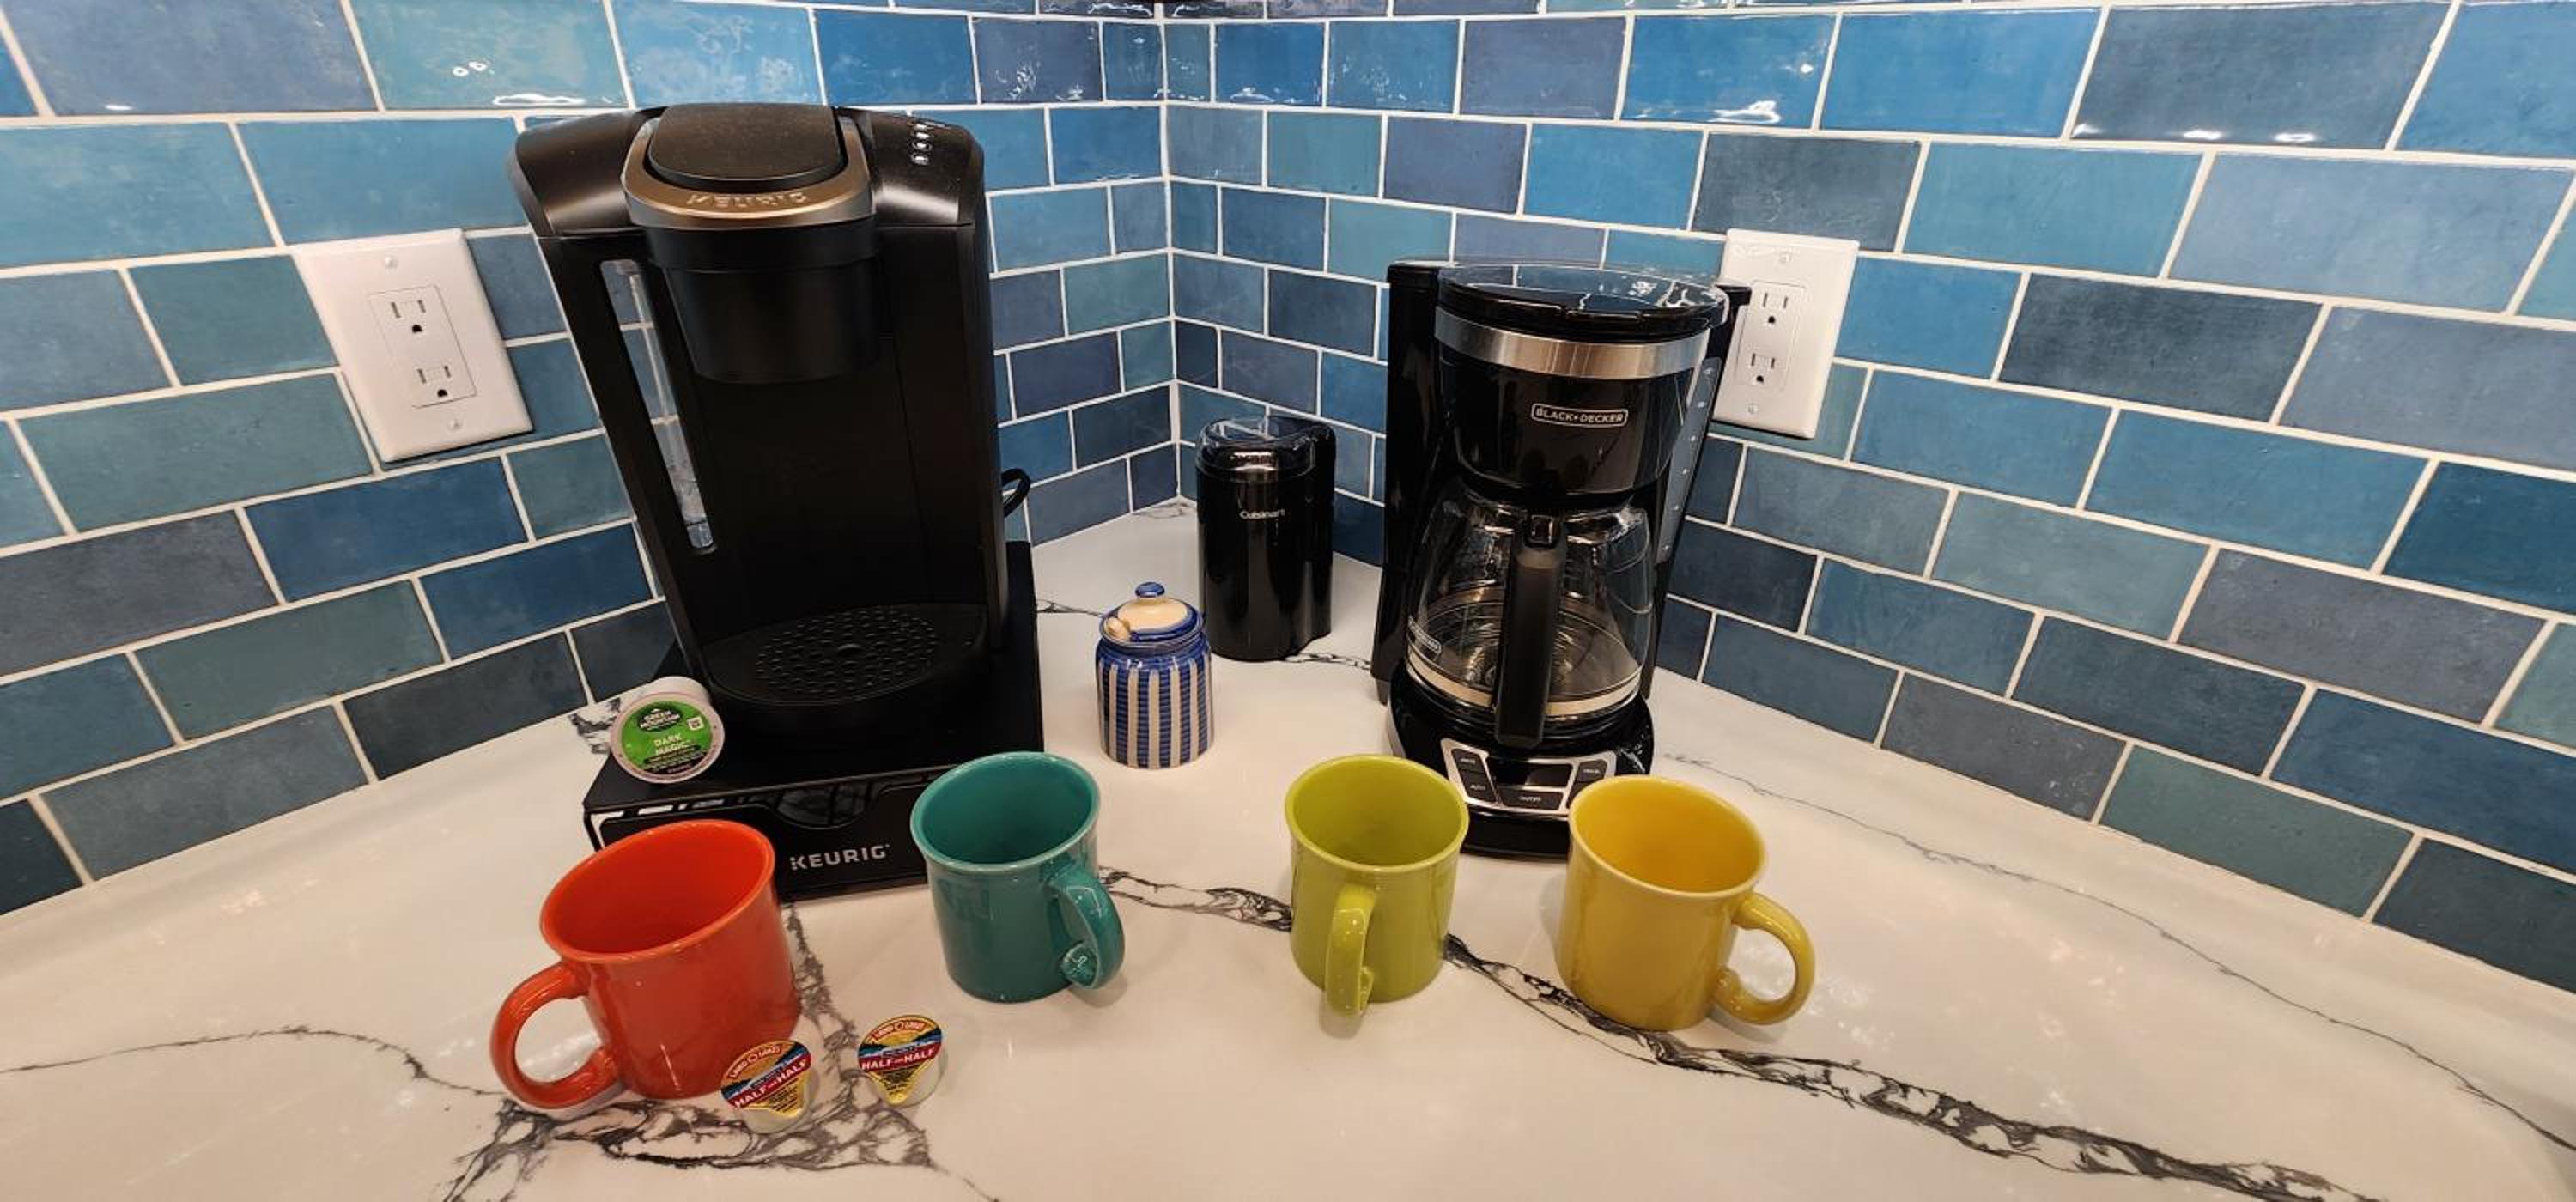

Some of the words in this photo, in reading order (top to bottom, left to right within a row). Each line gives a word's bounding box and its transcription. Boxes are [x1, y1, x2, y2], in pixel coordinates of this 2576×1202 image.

[686, 191, 808, 208] KEURIG
[1239, 508, 1285, 519] Cuisinart
[654, 734, 681, 746] DARK
[655, 742, 685, 756] MAGIC
[789, 845, 887, 871] KEURIG
[873, 1024, 894, 1038] LAND
[861, 1059, 893, 1071] HALF
[903, 1047, 935, 1063] HALF
[729, 1061, 748, 1078] LAND
[734, 1085, 767, 1108] HALF
[775, 1059, 806, 1083] HALF
